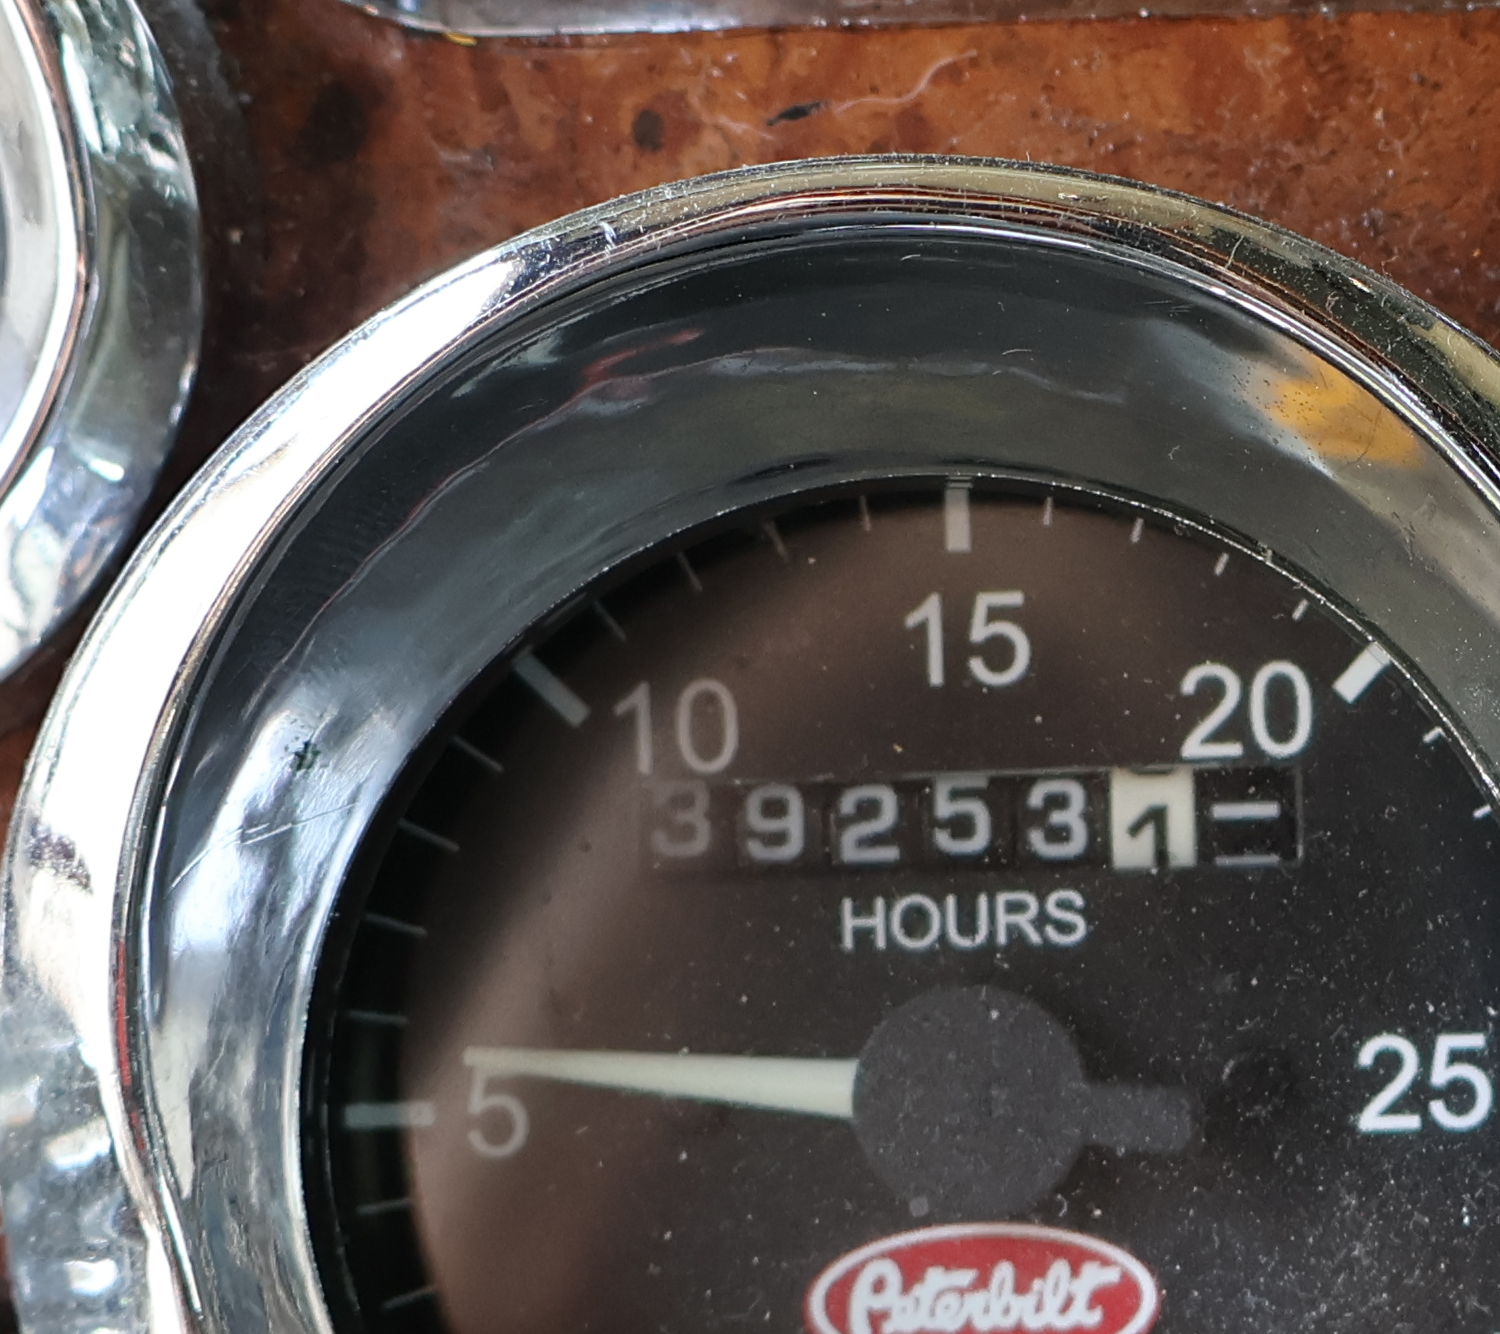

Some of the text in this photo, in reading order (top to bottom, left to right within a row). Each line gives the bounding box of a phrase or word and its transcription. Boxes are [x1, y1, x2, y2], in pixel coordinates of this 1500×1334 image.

[903, 592, 1032, 687] 15
[613, 679, 740, 776] 10
[1179, 660, 1313, 759] 20
[839, 887, 1090, 952] HOURS
[466, 1065, 530, 1158] 5
[1355, 1032, 1493, 1132] 25
